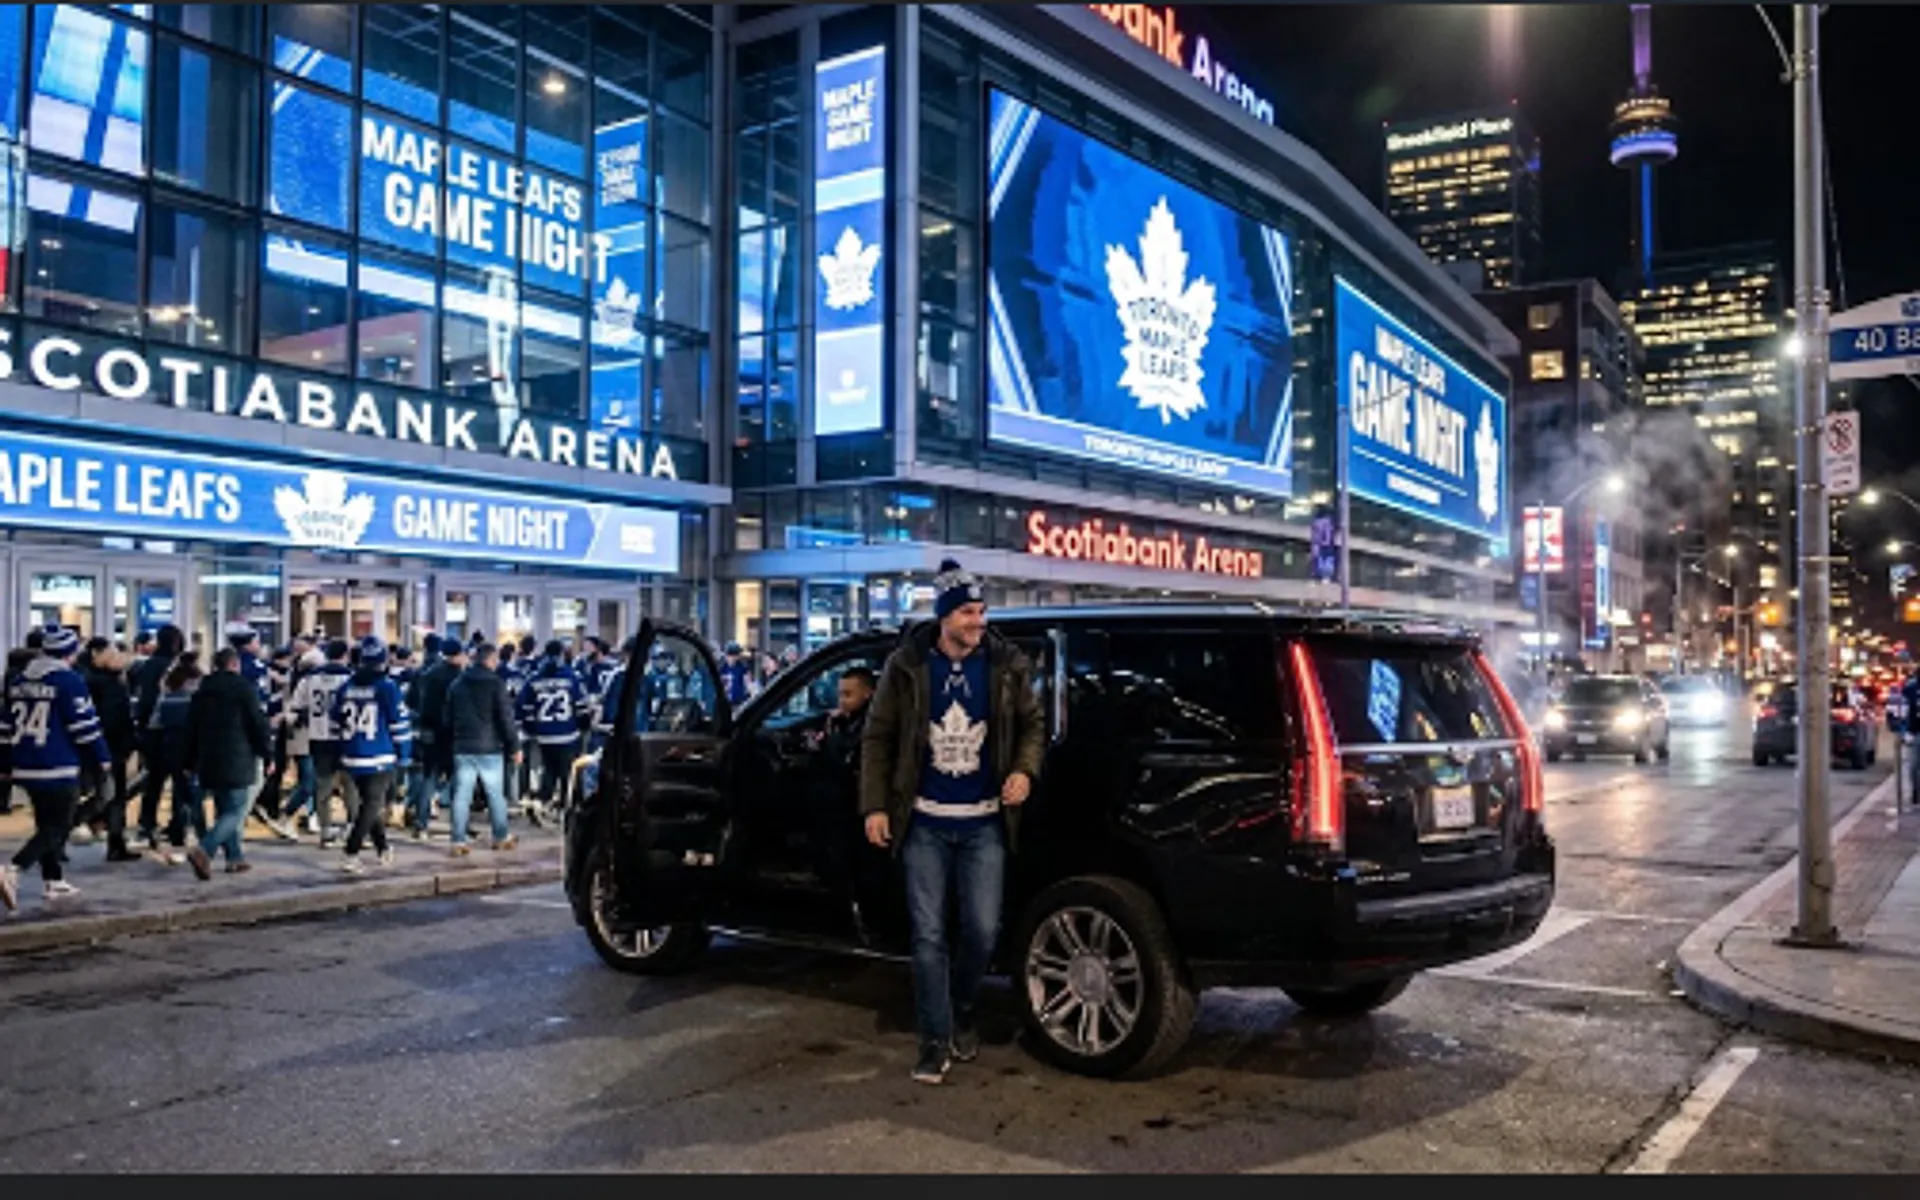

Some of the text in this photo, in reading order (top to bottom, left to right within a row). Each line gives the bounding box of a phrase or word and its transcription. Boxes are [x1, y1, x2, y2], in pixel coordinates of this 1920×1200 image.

[1089, 5, 1185, 68] bank
[361, 117, 481, 191] MAPLE
[486, 158, 582, 222] LEAFS
[383, 171, 495, 252] GAME
[1855, 328, 1887, 352] 40
[1350, 350, 1412, 455] GAME
[510, 418, 677, 481] ARENA
[114, 463, 242, 523] LEAFS
[392, 494, 481, 543] GAME
[487, 504, 568, 550] NIGHT
[1026, 510, 1188, 570] Scotiabank
[1192, 536, 1263, 579] Arena
[10, 700, 51, 748] 34
[342, 700, 379, 741] 34
[537, 690, 573, 722] 23
